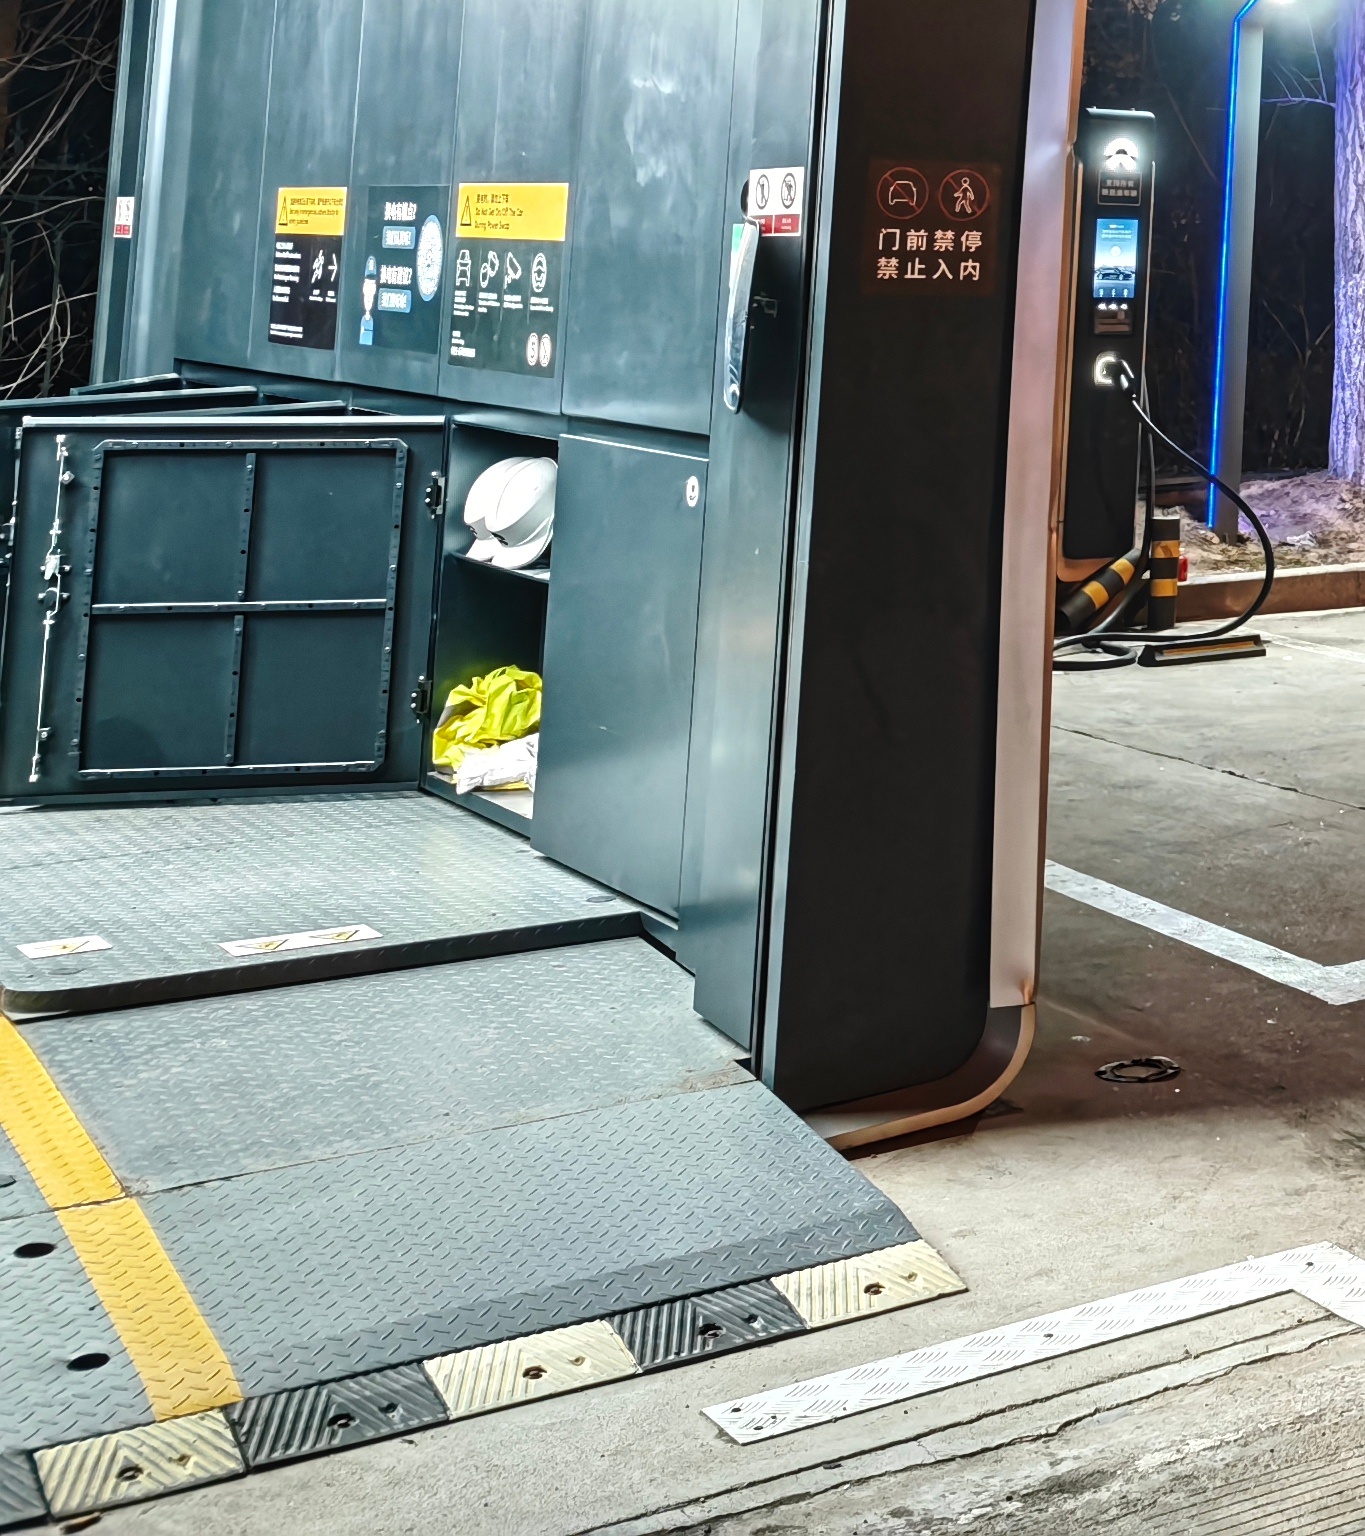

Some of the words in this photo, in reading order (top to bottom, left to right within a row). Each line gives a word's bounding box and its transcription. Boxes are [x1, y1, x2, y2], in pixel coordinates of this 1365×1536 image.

[878, 228, 983, 253] 门前禁停
[876, 256, 981, 281] 禁止入内
